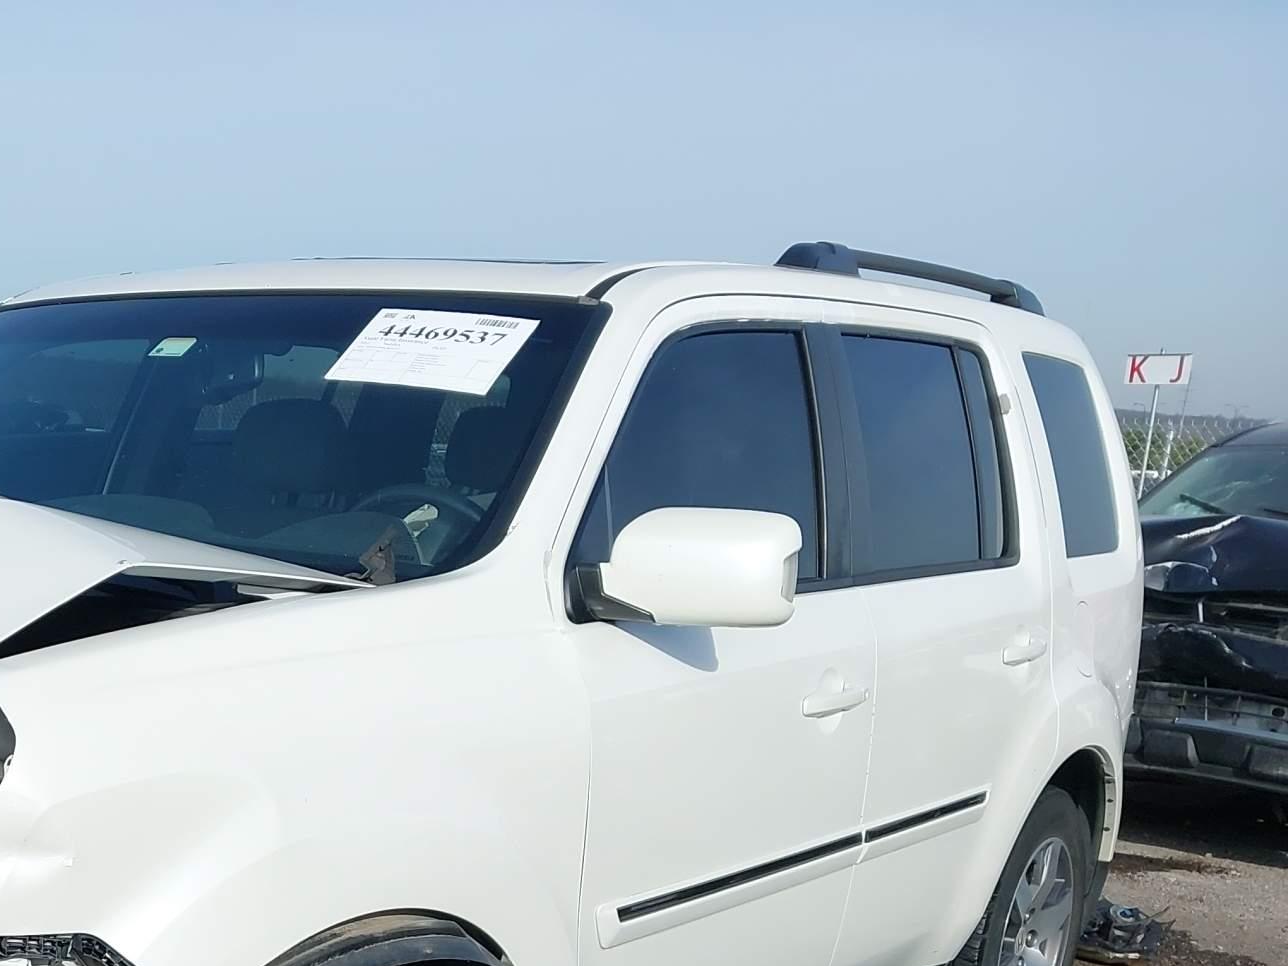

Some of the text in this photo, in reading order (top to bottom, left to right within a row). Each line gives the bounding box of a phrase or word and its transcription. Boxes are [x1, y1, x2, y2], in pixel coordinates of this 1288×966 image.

[378, 323, 507, 346] 44469537
[1128, 354, 1185, 383] K J
